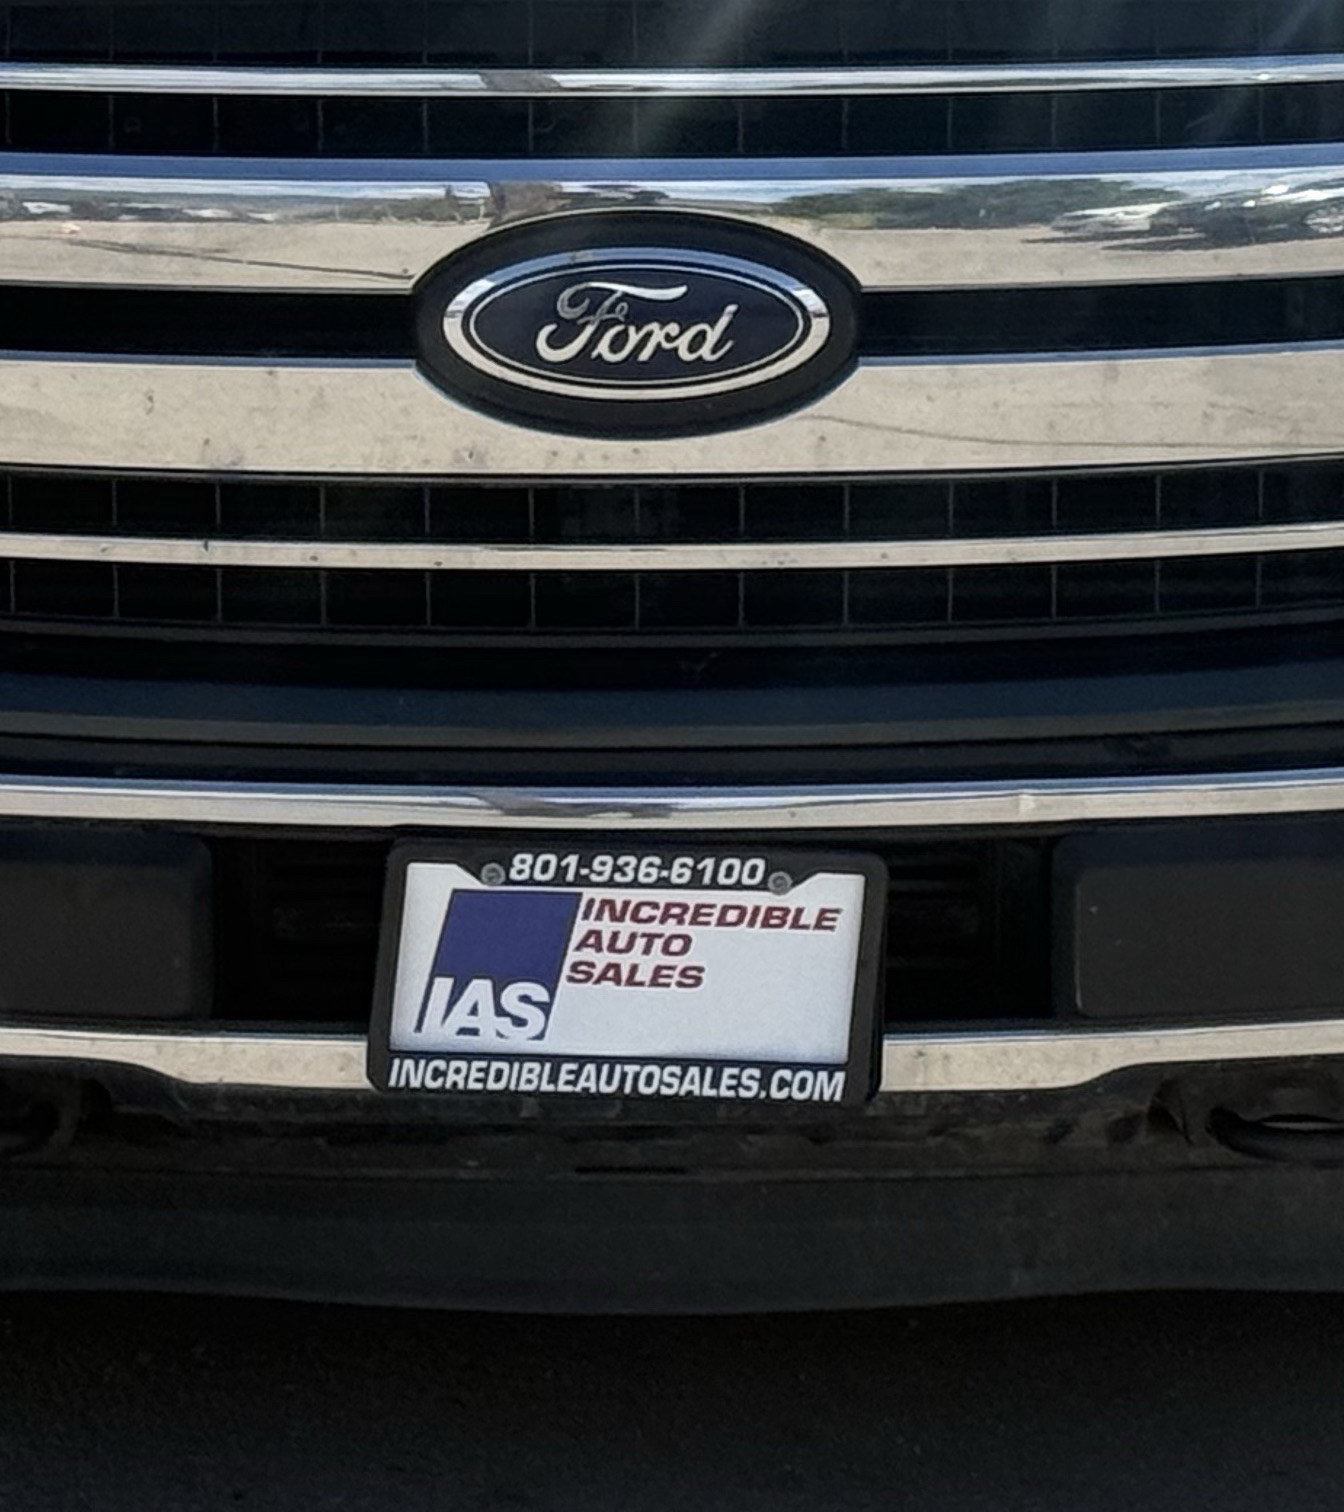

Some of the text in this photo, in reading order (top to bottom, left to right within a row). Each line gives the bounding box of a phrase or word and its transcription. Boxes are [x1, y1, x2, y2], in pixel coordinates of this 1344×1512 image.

[535, 281, 740, 364] Ford
[508, 852, 766, 887] 801-936-6100
[581, 898, 843, 931] INCREDIBLE
[572, 929, 693, 957] AUTO
[564, 960, 706, 990] SALES
[419, 976, 550, 1040] IAS
[387, 1057, 846, 1103] INCREDIBLEAUTOSALES.COM
